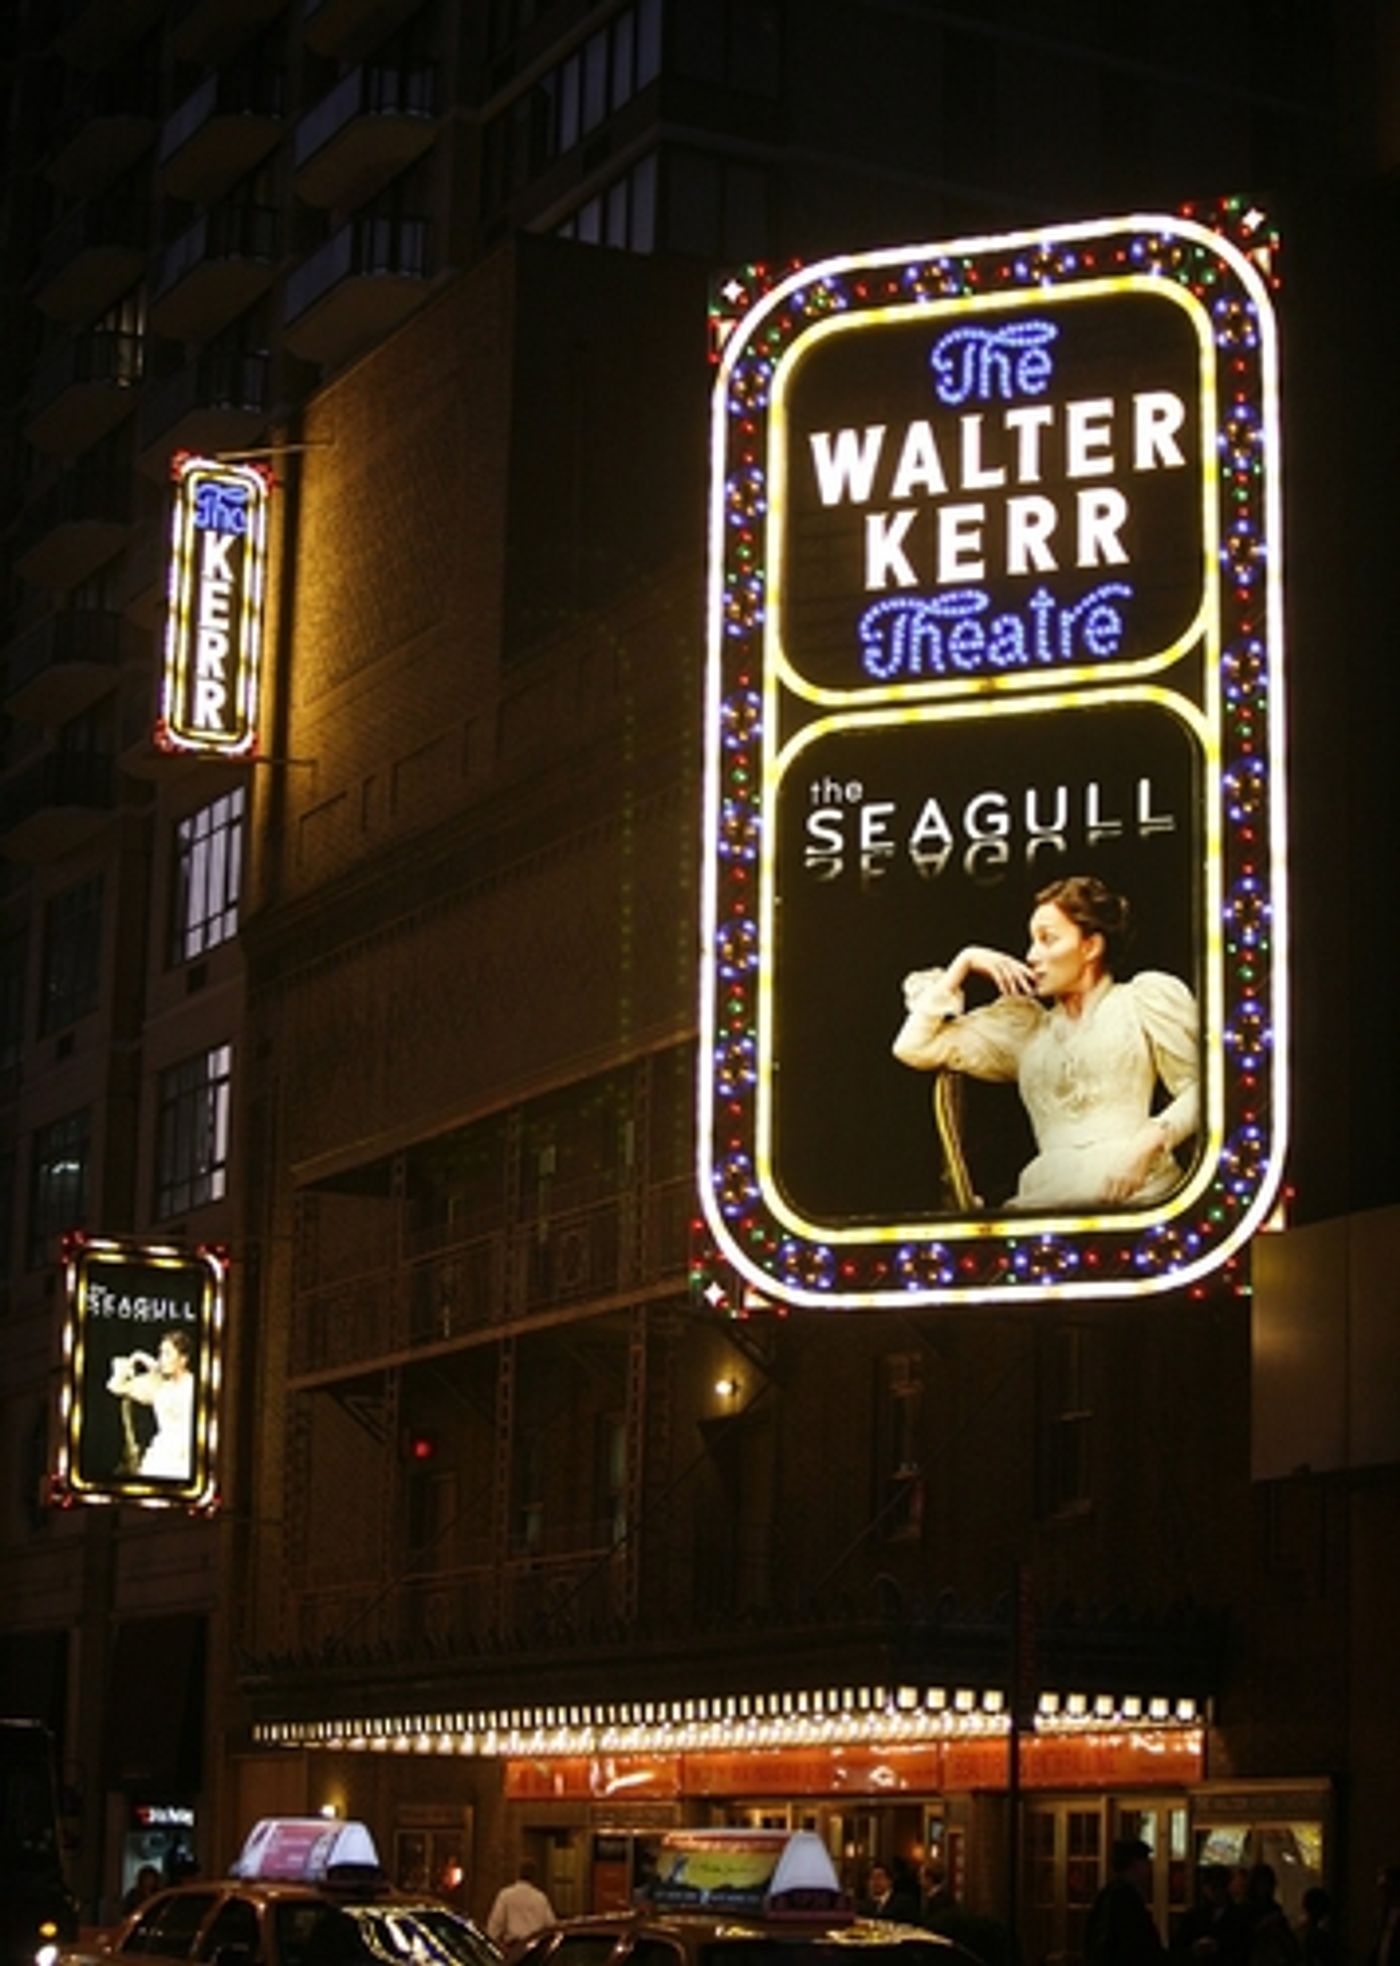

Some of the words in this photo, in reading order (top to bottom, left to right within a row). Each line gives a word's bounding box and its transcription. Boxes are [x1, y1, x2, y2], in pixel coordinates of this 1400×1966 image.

[930, 319, 1059, 405] The
[809, 391, 1186, 506] WALTER
[863, 488, 1131, 590] KERR
[194, 531, 234, 729] KERR
[858, 583, 1134, 679] Theatre
[805, 777, 1175, 856] SEAGULL
[809, 777, 864, 804] the
